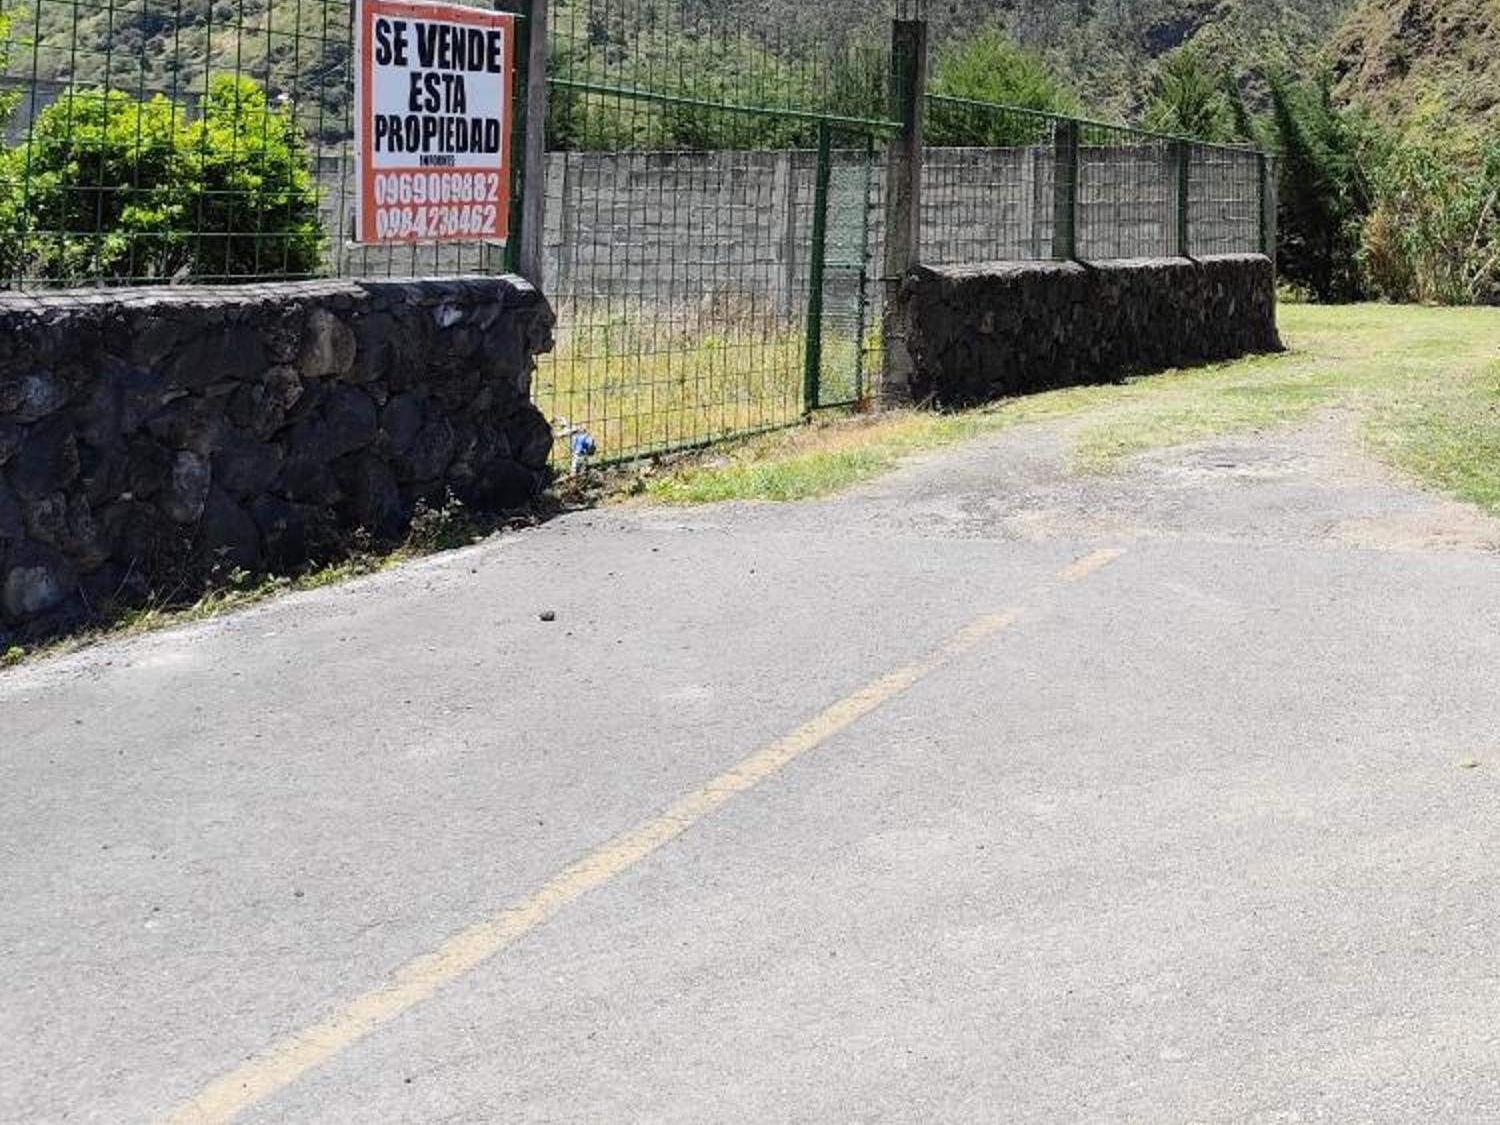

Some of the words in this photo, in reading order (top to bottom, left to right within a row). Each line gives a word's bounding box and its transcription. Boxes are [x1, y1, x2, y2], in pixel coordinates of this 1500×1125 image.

[375, 18, 408, 66] SE
[415, 22, 501, 73] VENDE
[409, 72, 466, 113] ESTA
[374, 114, 500, 154] PROPIEDAD
